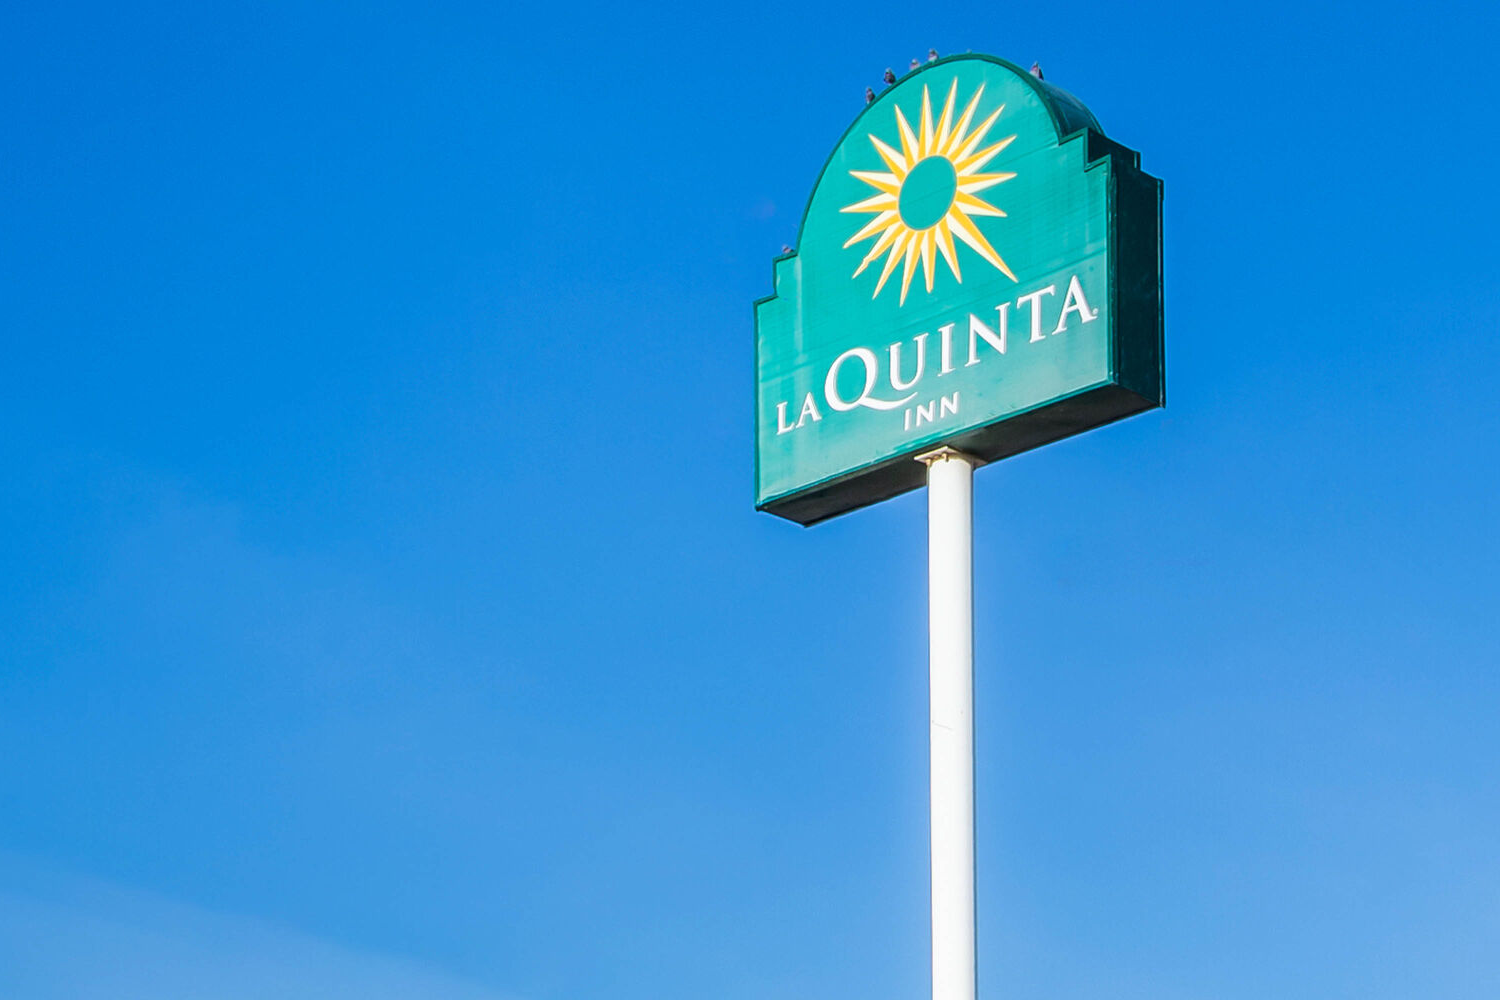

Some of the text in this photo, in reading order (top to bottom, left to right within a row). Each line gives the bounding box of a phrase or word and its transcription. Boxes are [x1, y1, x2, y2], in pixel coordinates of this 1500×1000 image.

[776, 274, 1098, 436] LA QUINTA
[903, 391, 960, 432] INN
